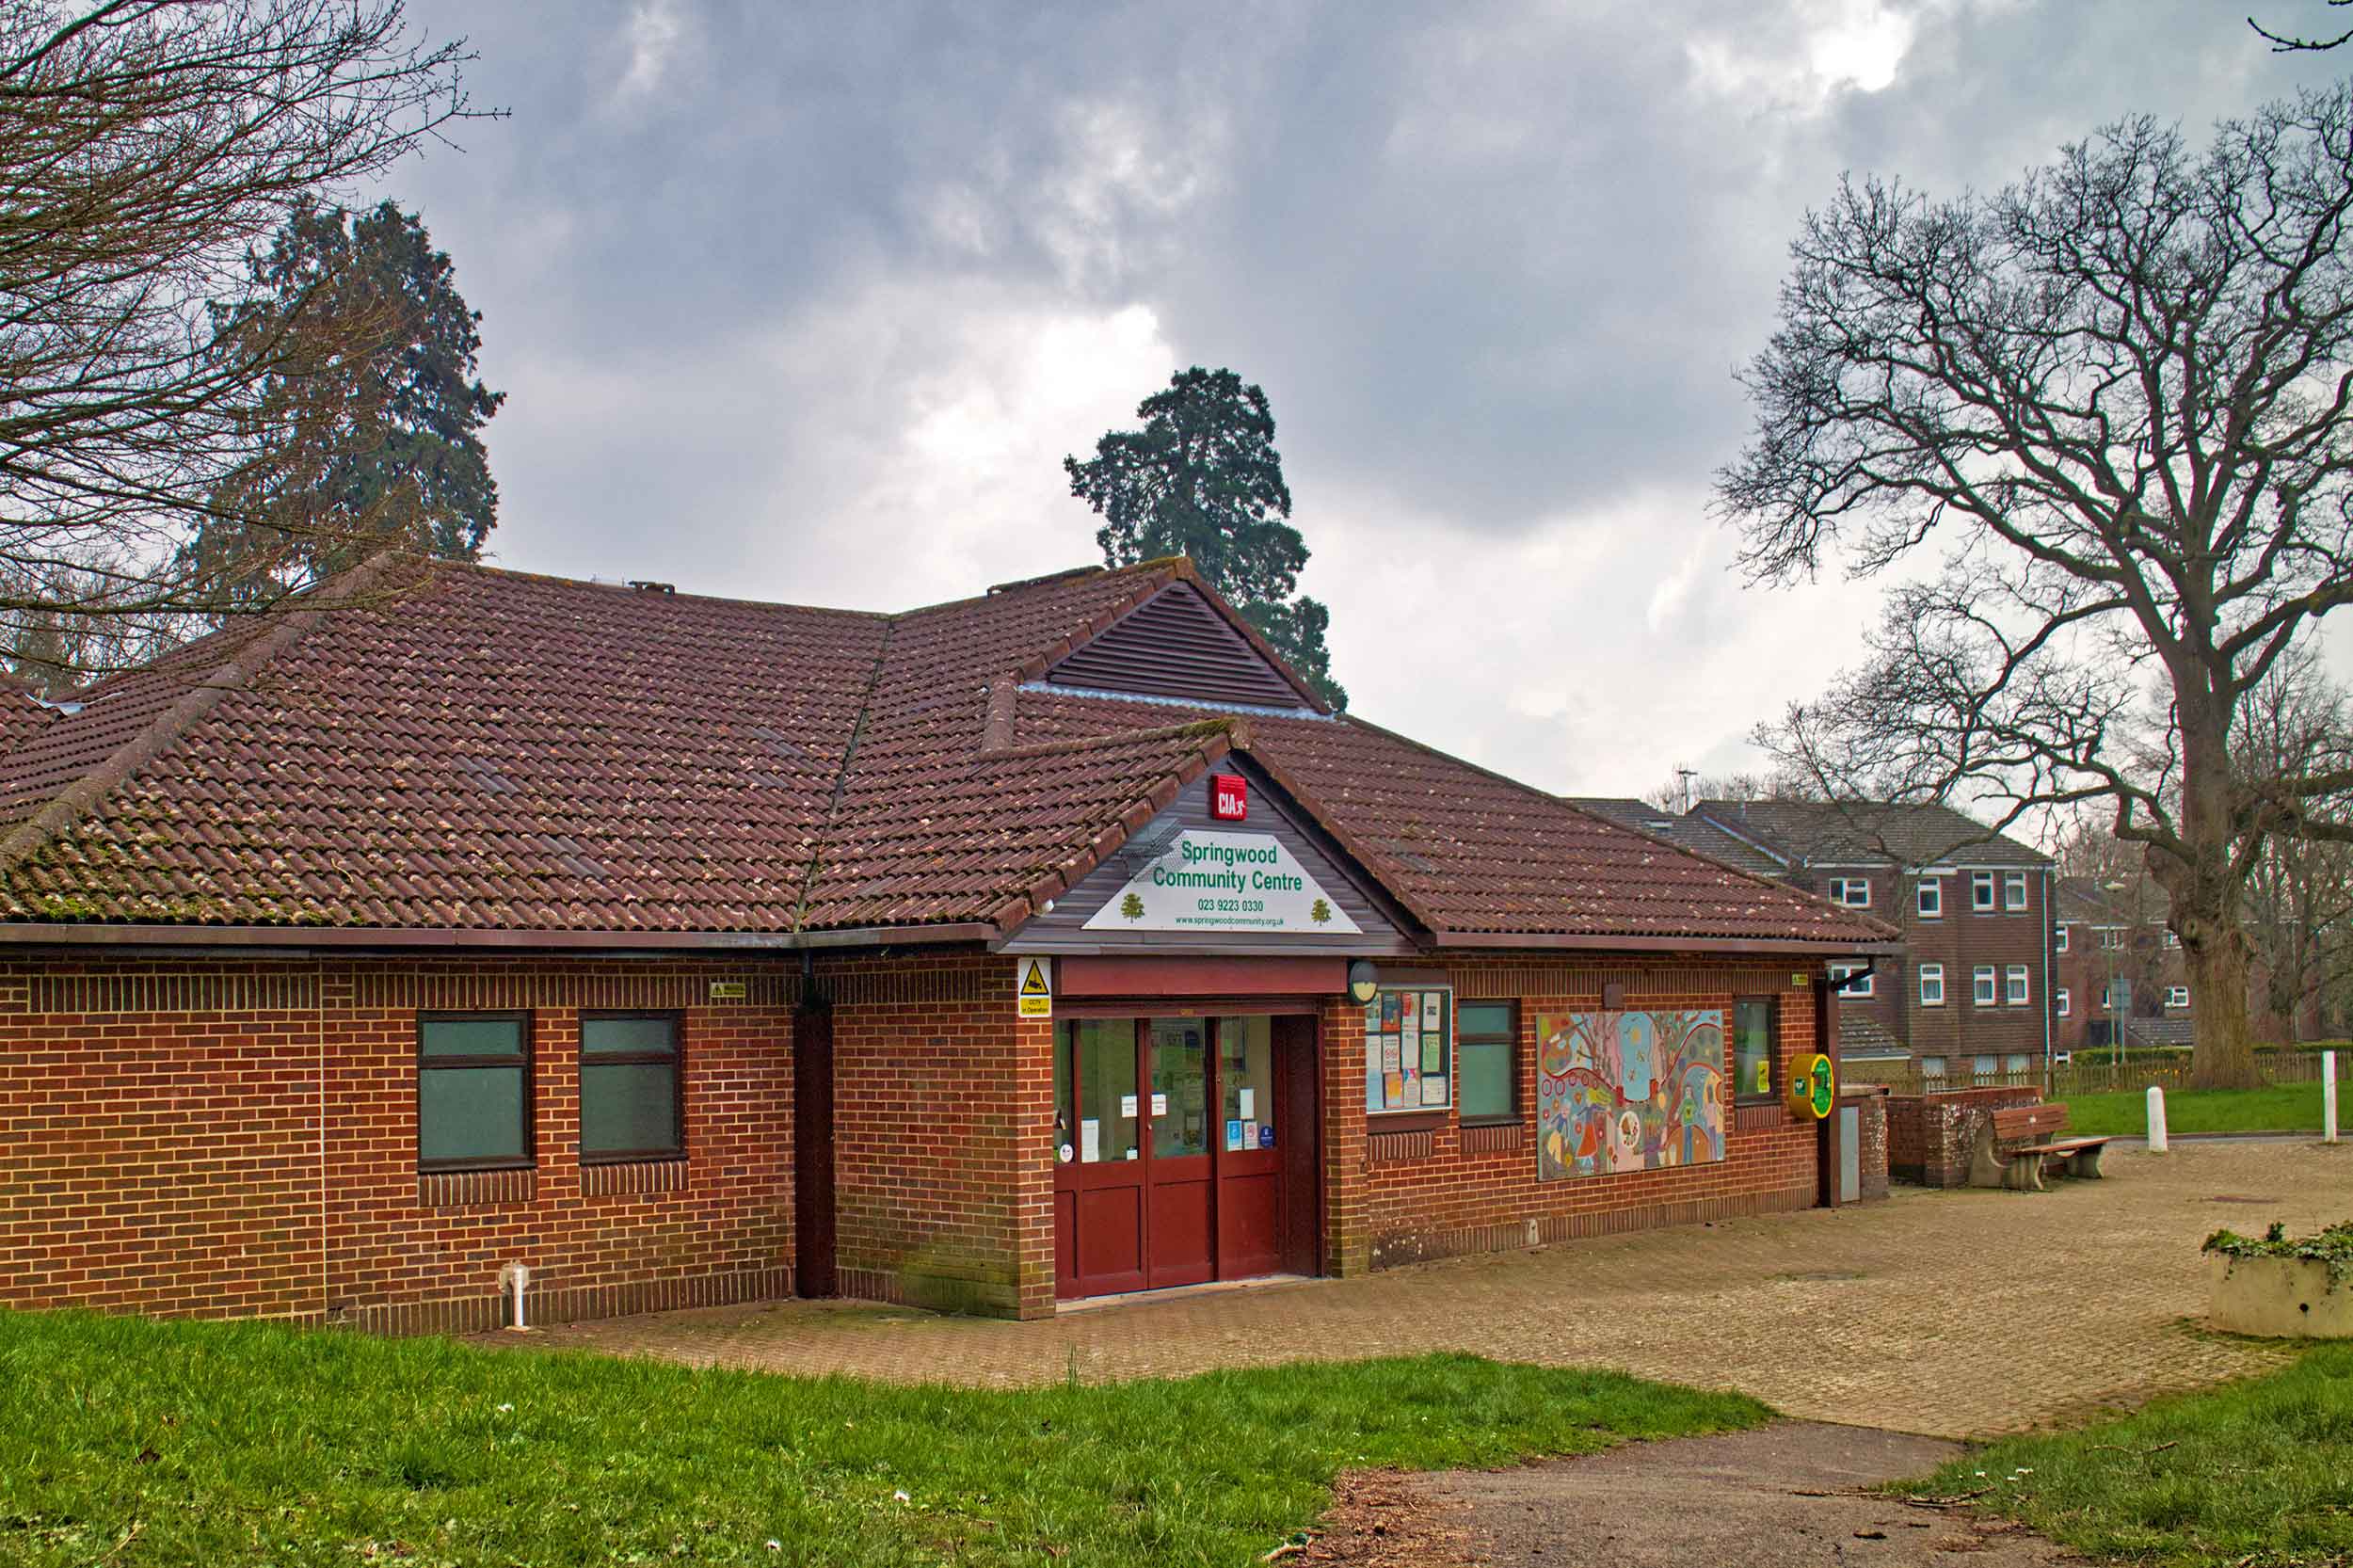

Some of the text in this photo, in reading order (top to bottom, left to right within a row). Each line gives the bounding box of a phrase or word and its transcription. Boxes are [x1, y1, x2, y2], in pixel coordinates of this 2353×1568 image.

[1219, 792, 1236, 814] CIA
[1181, 840, 1277, 867] Springwood
[1153, 867, 1303, 893] Community Centre
[1197, 898, 1264, 912] 023 9223 0330
[1176, 917, 1284, 927] www.springwoodcommunity.org.uk
